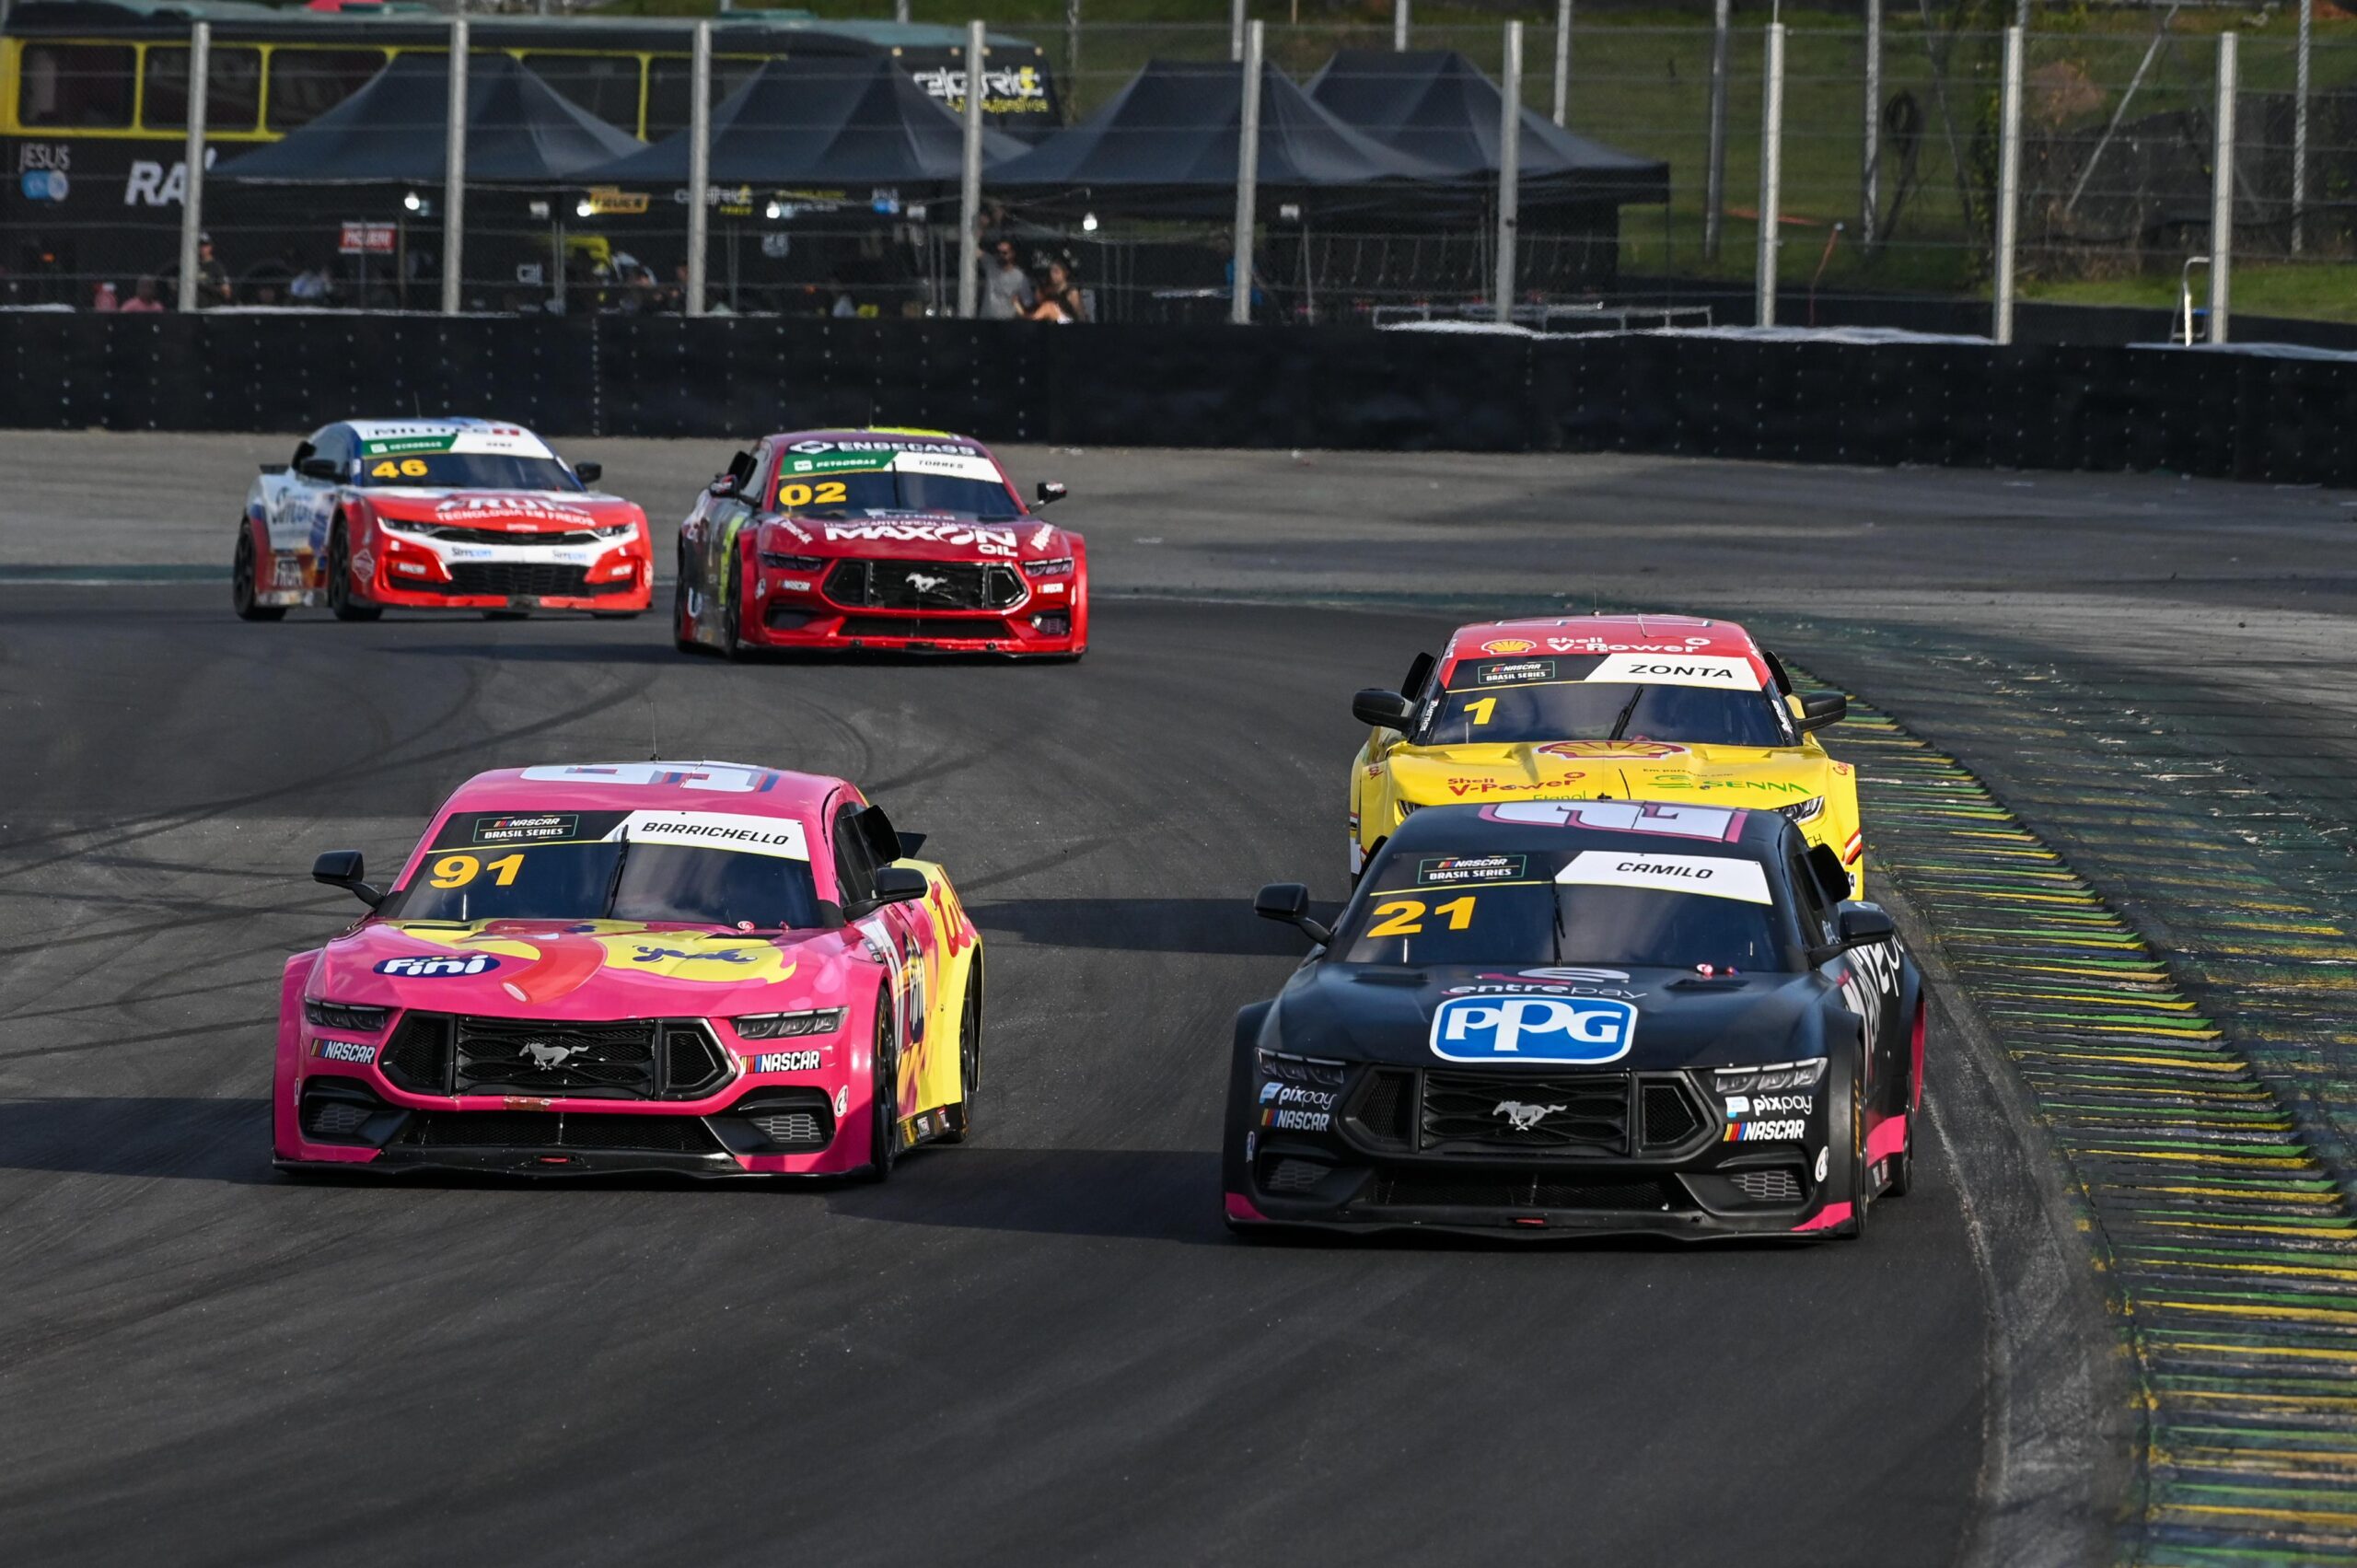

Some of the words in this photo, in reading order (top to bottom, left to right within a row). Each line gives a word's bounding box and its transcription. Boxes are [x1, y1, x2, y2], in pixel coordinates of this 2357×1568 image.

[18, 143, 70, 173] JESUS
[372, 459, 428, 478] 46
[918, 459, 965, 469] TORRES
[779, 482, 847, 506] 02
[825, 526, 1017, 547] MAXON
[978, 543, 1018, 557] OIL
[1548, 642, 1701, 654] V-Power
[1486, 673, 1515, 682] BRASIL
[1517, 671, 1546, 680] SERIES
[1502, 663, 1541, 672] NASCAR
[1629, 664, 1734, 679] ZONTA
[1464, 698, 1497, 725] 1
[1448, 779, 1576, 796] V-Power
[1701, 780, 1812, 796] SENNA
[511, 818, 560, 828] NASCAR
[484, 830, 525, 840] BRASIL
[527, 827, 563, 838] SERIES
[641, 821, 790, 846] BARRICHELLO
[429, 854, 526, 889] 91
[1454, 857, 1508, 868] NASCAR
[1616, 861, 1714, 880] CAMILO
[1429, 870, 1469, 881] BRASIL
[1471, 867, 1512, 879] SERIES
[1366, 896, 1477, 938] 21
[383, 955, 490, 976] Fini
[1448, 981, 1648, 1000] entrepay
[1445, 999, 1623, 1051] PPG
[324, 1043, 375, 1064] NASCAR
[759, 1051, 821, 1073] NASCAR
[1278, 1086, 1337, 1110] pixpay
[1753, 1094, 1813, 1116] pixpay
[1277, 1109, 1329, 1132] NASCAR
[1743, 1119, 1805, 1142] NASCAR
